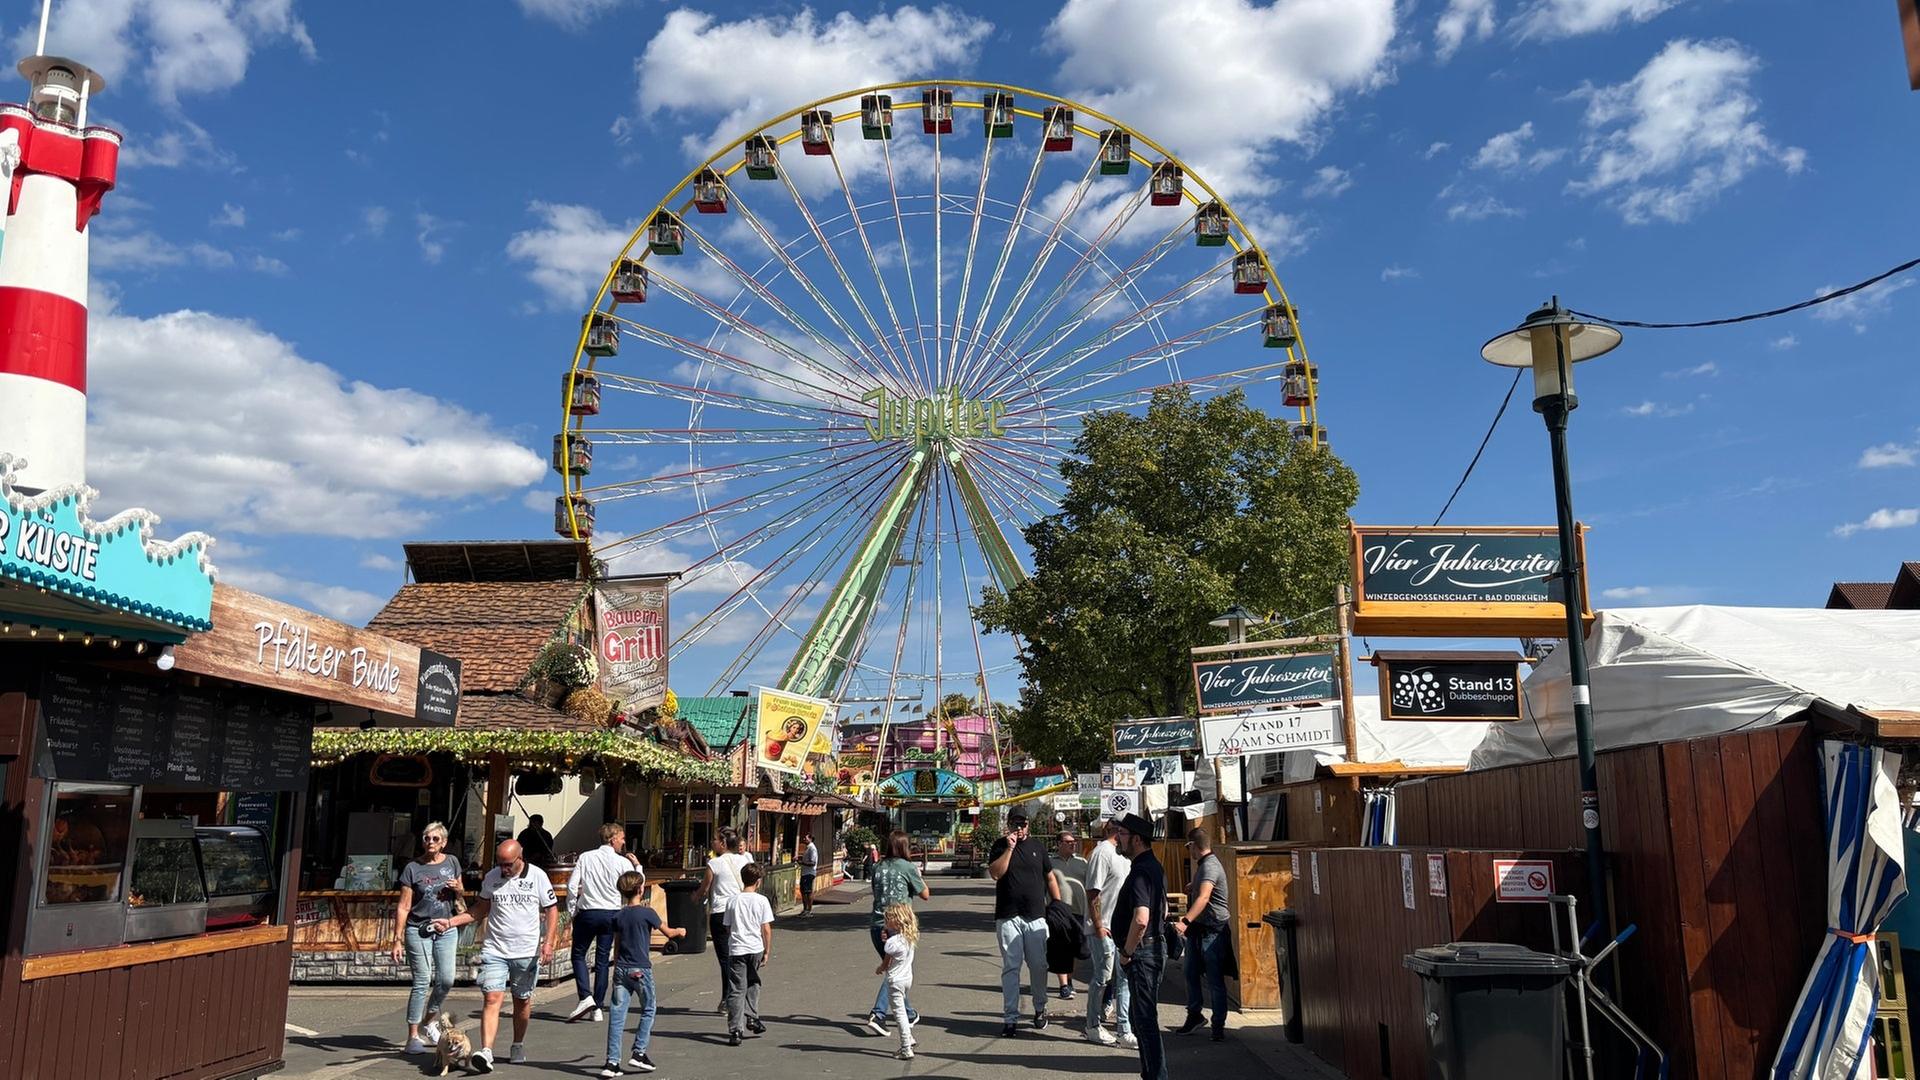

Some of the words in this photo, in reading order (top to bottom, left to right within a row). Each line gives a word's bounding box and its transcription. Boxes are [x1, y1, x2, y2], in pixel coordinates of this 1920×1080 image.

[862, 384, 1006, 447] Jupiter
[16, 512, 100, 581] KÜSTE
[1364, 539, 1418, 575] Vier
[1410, 543, 1560, 586] Jahreszeiten
[1365, 593, 1477, 601] WINZERGENOSSENSCHAFT
[1485, 593, 1502, 601] BAD
[603, 626, 665, 663] Grill
[255, 618, 345, 679] Pfälzer
[351, 648, 400, 694] Bude
[1199, 665, 1236, 692] Vier
[1231, 664, 1332, 697] Jahreszeiten
[1449, 677, 1494, 691] Stand
[1495, 678, 1514, 691] 13
[1449, 691, 1514, 702] Dubbeschuppe
[1242, 720, 1284, 732] STAND
[1288, 717, 1301, 728] 17
[1115, 726, 1137, 742] Vier
[1219, 737, 1262, 750] ADAM
[1266, 730, 1331, 746] SCHMIDT
[1115, 766, 1136, 774] Stand
[1115, 772, 1136, 787] 25
[510, 894, 532, 903] YORK
